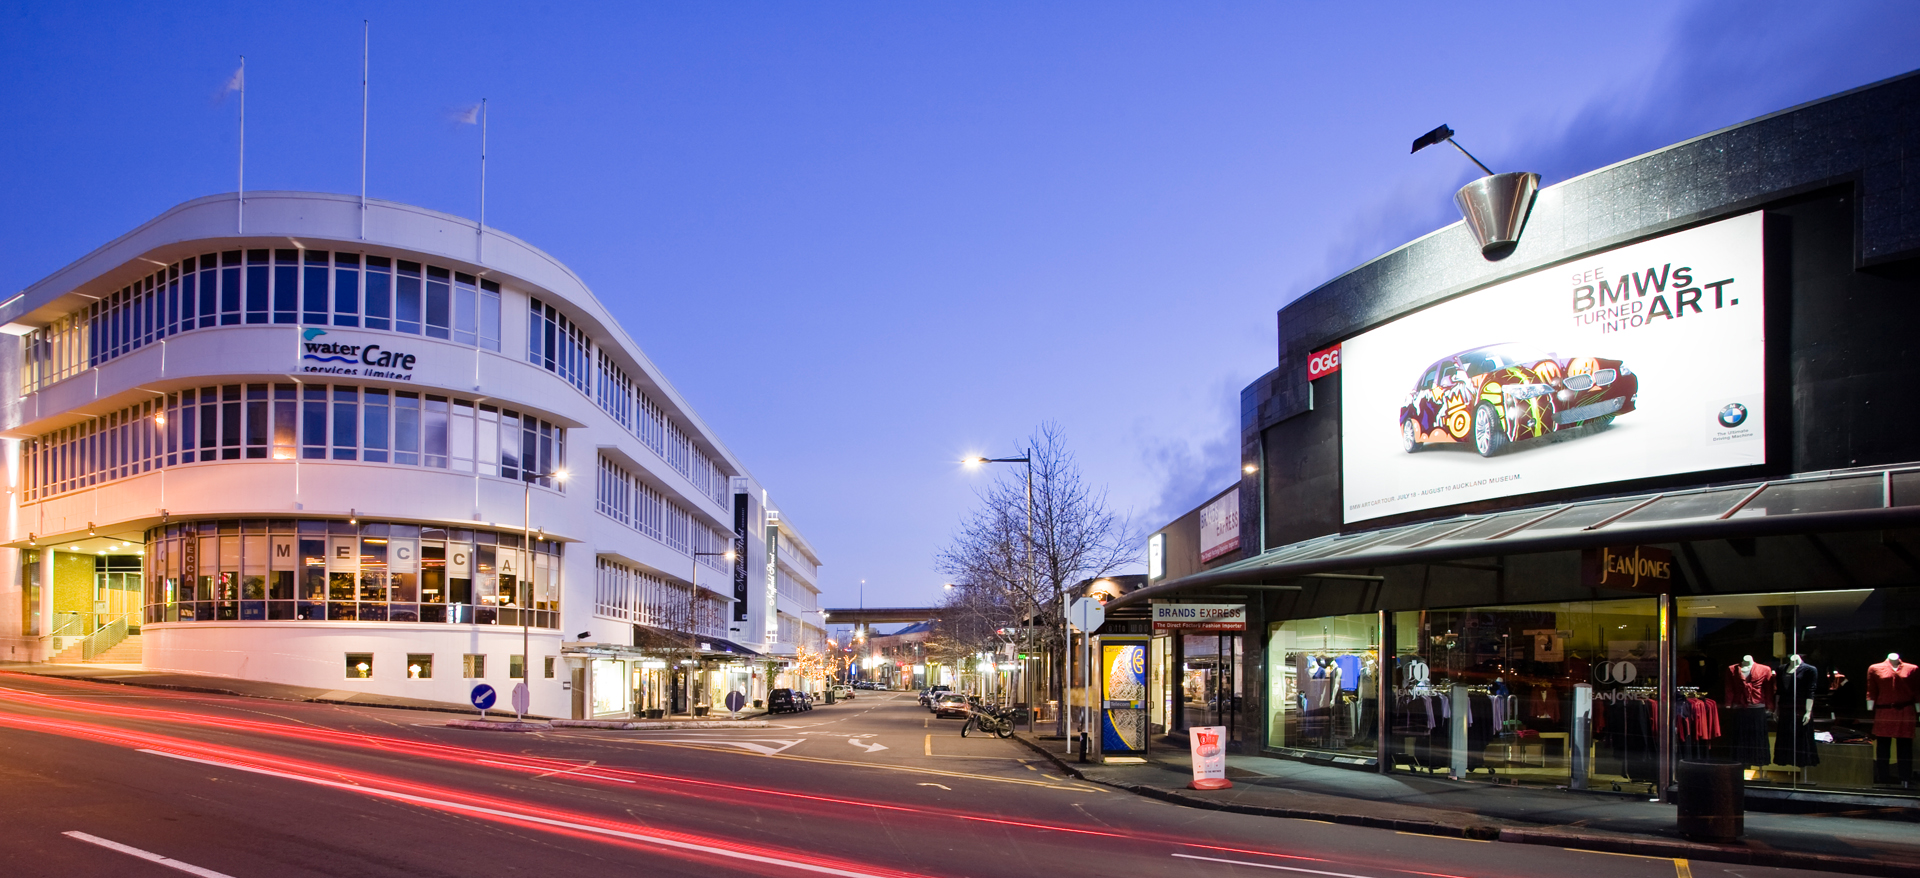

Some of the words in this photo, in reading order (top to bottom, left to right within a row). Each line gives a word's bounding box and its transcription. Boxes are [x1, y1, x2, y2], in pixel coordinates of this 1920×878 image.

[1572, 267, 1604, 286] SEE
[1572, 263, 1693, 314] BMWs
[1573, 301, 1643, 327] TURNED
[1602, 314, 1644, 334] INTO
[304, 342, 360, 356] water
[362, 344, 416, 370] Care
[303, 365, 358, 375] services
[364, 368, 412, 380] limited
[1349, 503, 1361, 511] BMW
[1397, 493, 1410, 501] JULY
[1421, 486, 1444, 496] AUGUST
[1452, 479, 1487, 490] AUCKLAND
[185, 536, 195, 582] MECCA
[1158, 608, 1196, 618] BRANDS
[1199, 608, 1241, 618] EXPRESS
